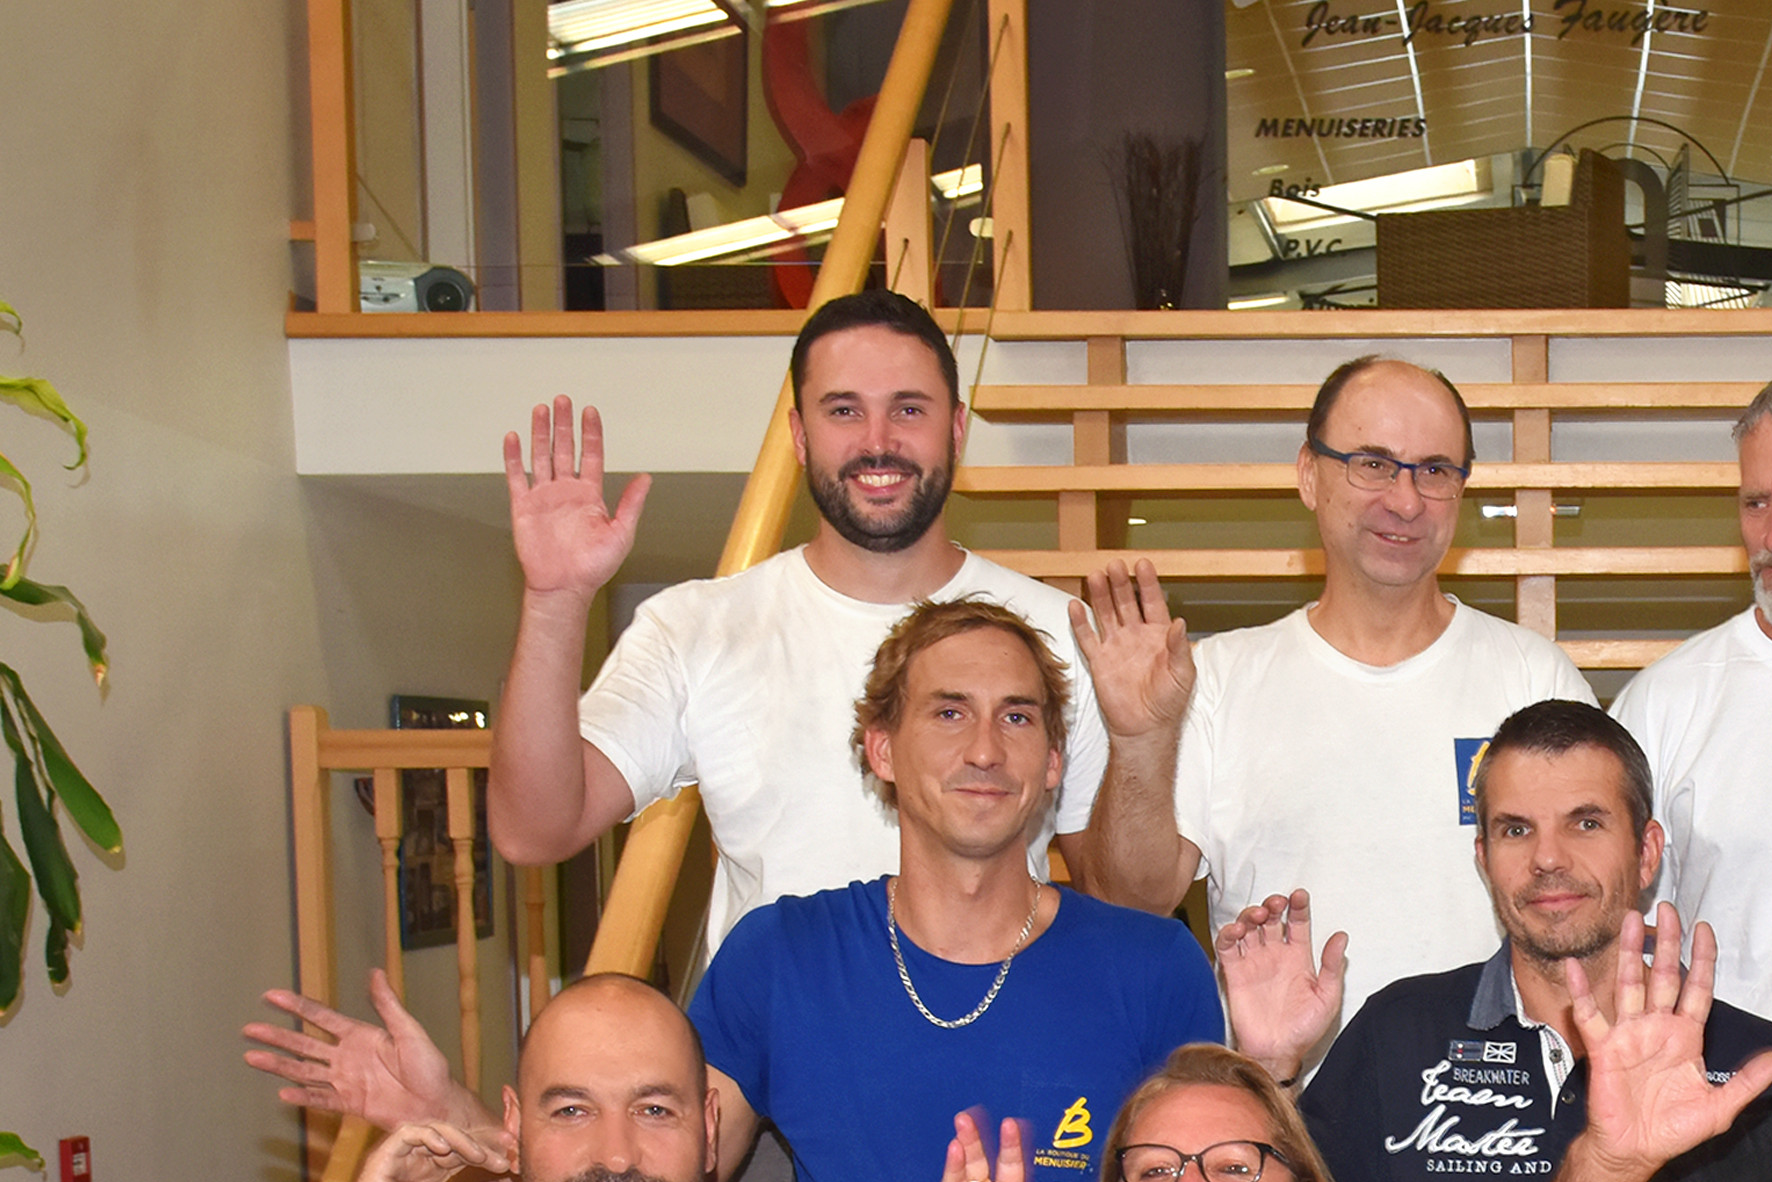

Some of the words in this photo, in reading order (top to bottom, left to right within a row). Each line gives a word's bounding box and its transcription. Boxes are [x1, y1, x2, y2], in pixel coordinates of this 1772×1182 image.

[1302, 1, 1535, 48] Jean-Jacques
[1554, 0, 1709, 46] Faugère
[1255, 118, 1427, 138] MENUISERIES
[1269, 177, 1321, 197] Bois
[1453, 1067, 1531, 1086] BREAKWATER
[1426, 1159, 1503, 1173] SAILING
[1509, 1161, 1552, 1175] AND
